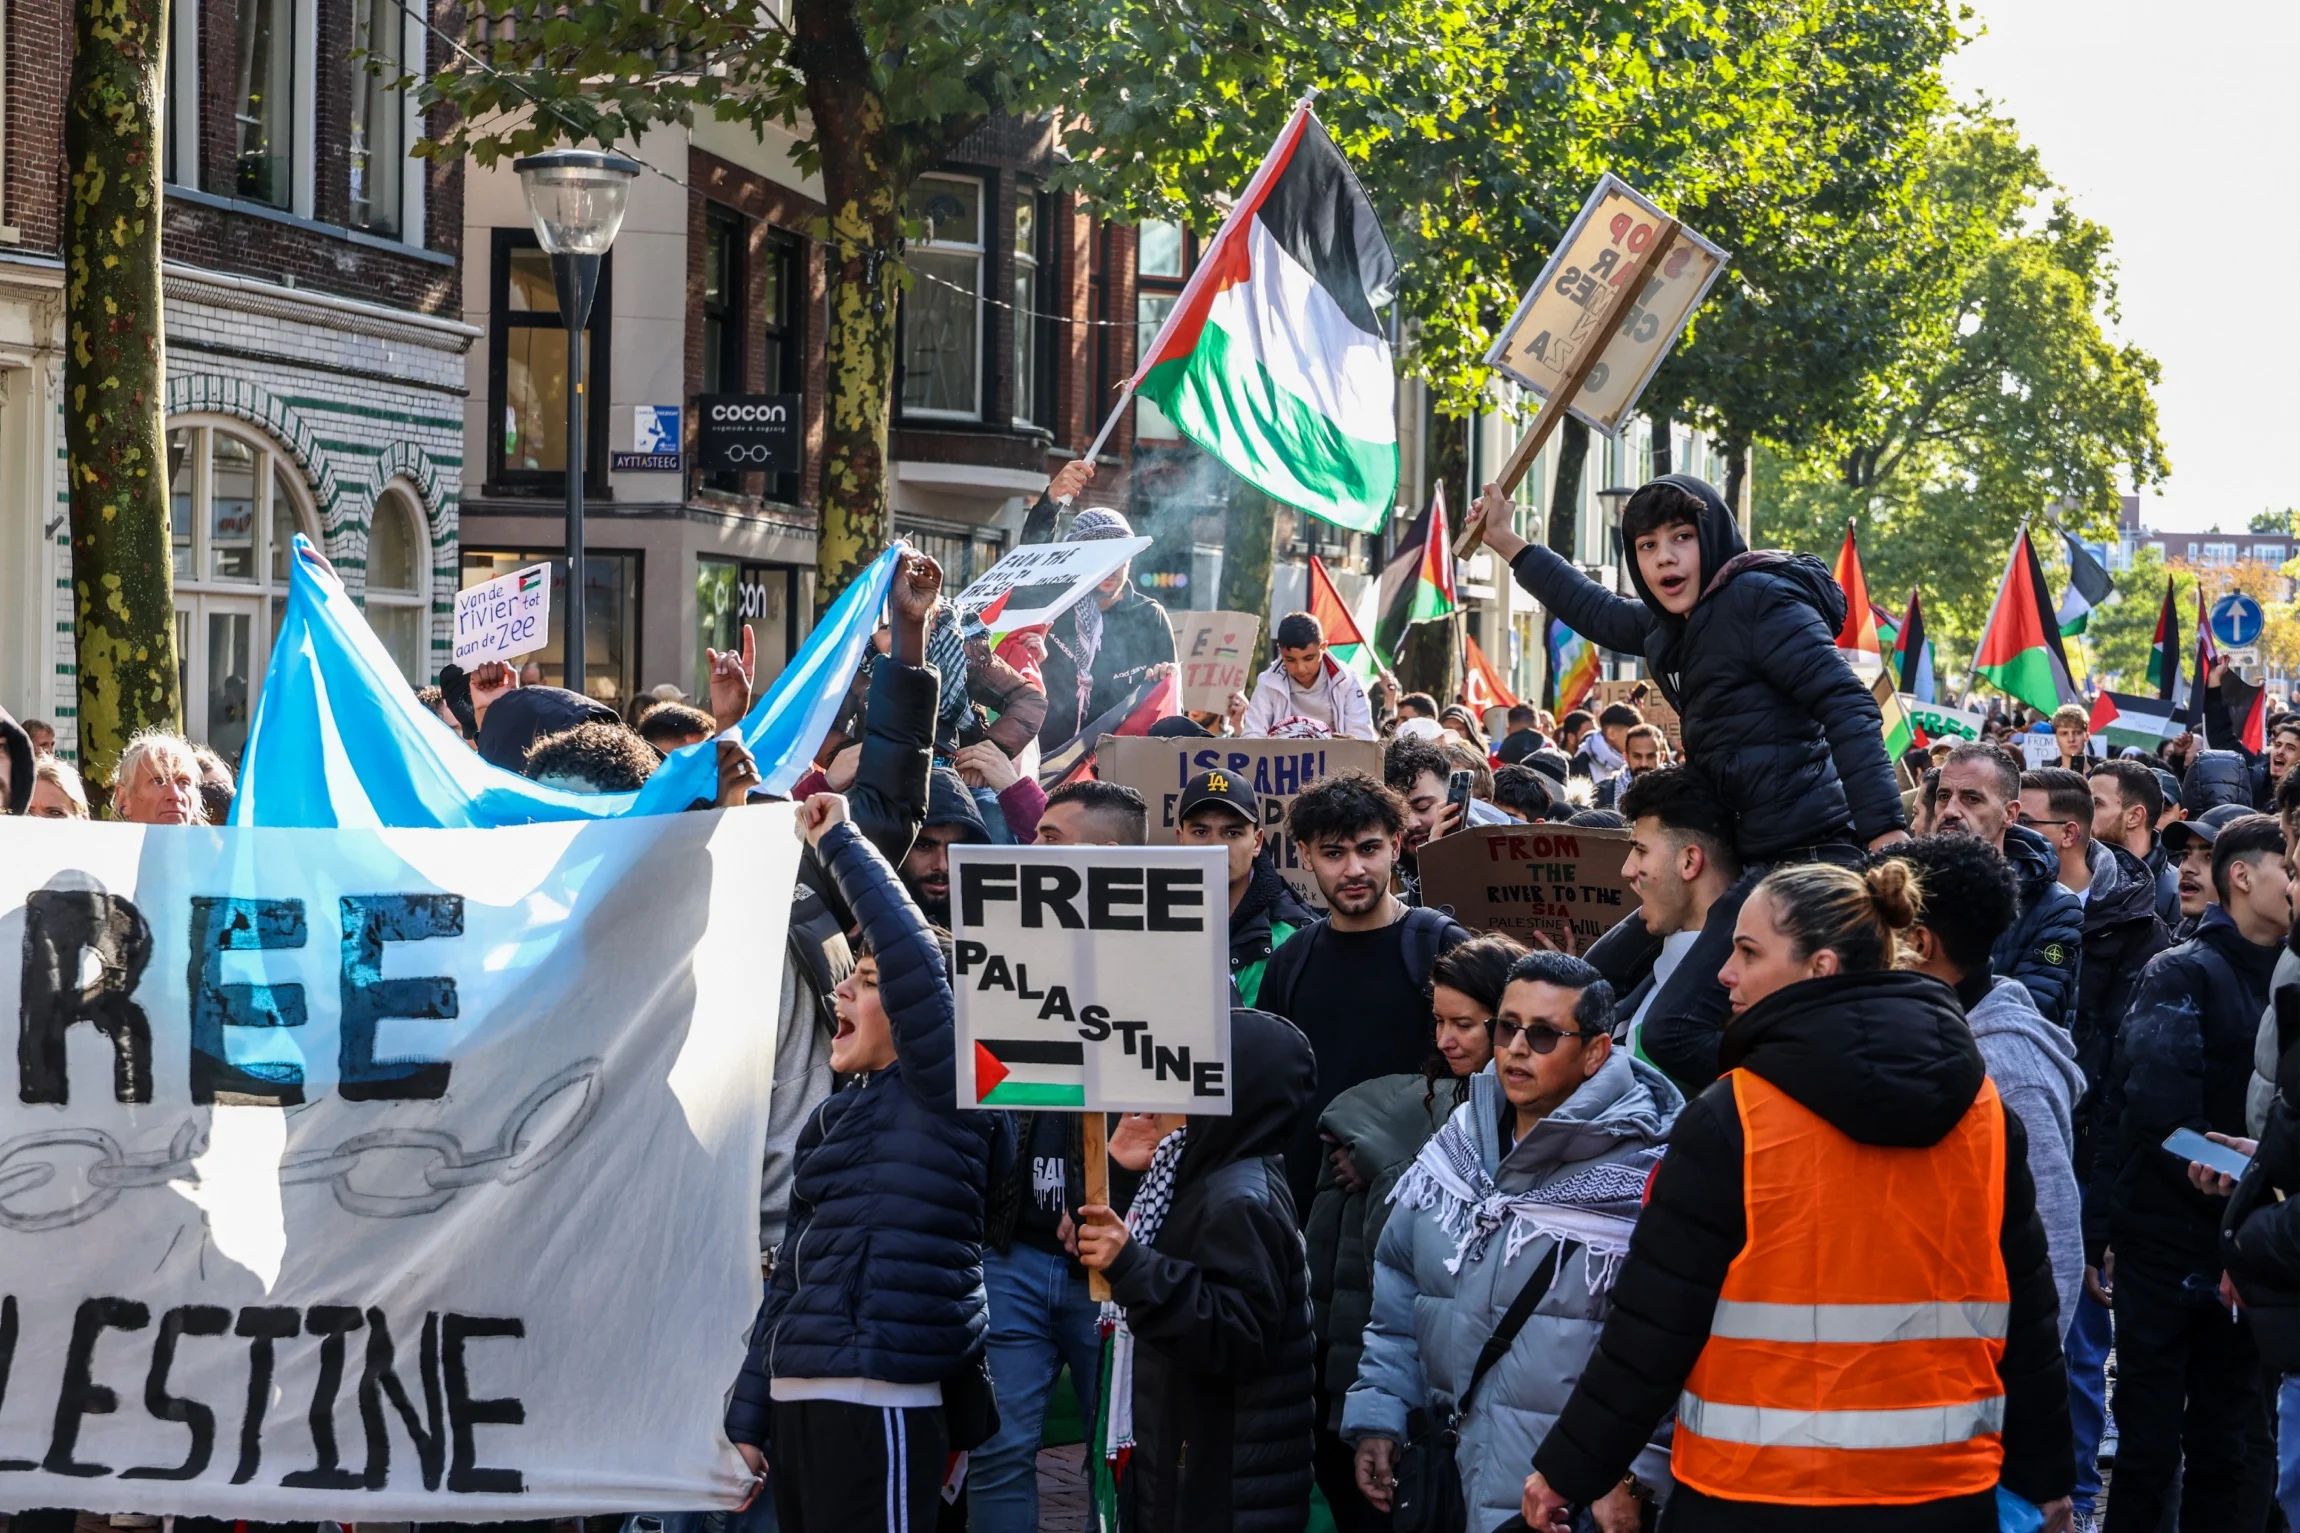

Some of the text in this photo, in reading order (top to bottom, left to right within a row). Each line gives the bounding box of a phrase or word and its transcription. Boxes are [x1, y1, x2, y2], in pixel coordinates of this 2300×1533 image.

[711, 404, 786, 422] cocon
[617, 456, 677, 468] AYTTASTEEG
[997, 547, 1081, 570] FROM THE
[460, 583, 504, 611] van de
[459, 592, 540, 635] rivier tot
[456, 640, 479, 658] aan
[481, 633, 495, 648] de
[1910, 711, 1978, 742] FREE
[2027, 735, 2054, 747] FROM
[2034, 747, 2049, 758] TO
[1207, 772, 1228, 793] LA
[1486, 835, 1580, 862] FROM
[1525, 863, 1576, 883] THE
[959, 863, 1204, 932] FREE
[1486, 885, 1622, 906] RIVER TO THE
[1532, 903, 1570, 918] SEA
[1569, 918, 1602, 937] WILL
[19, 890, 465, 1106] REE
[955, 939, 1225, 1097] PALASTINE
